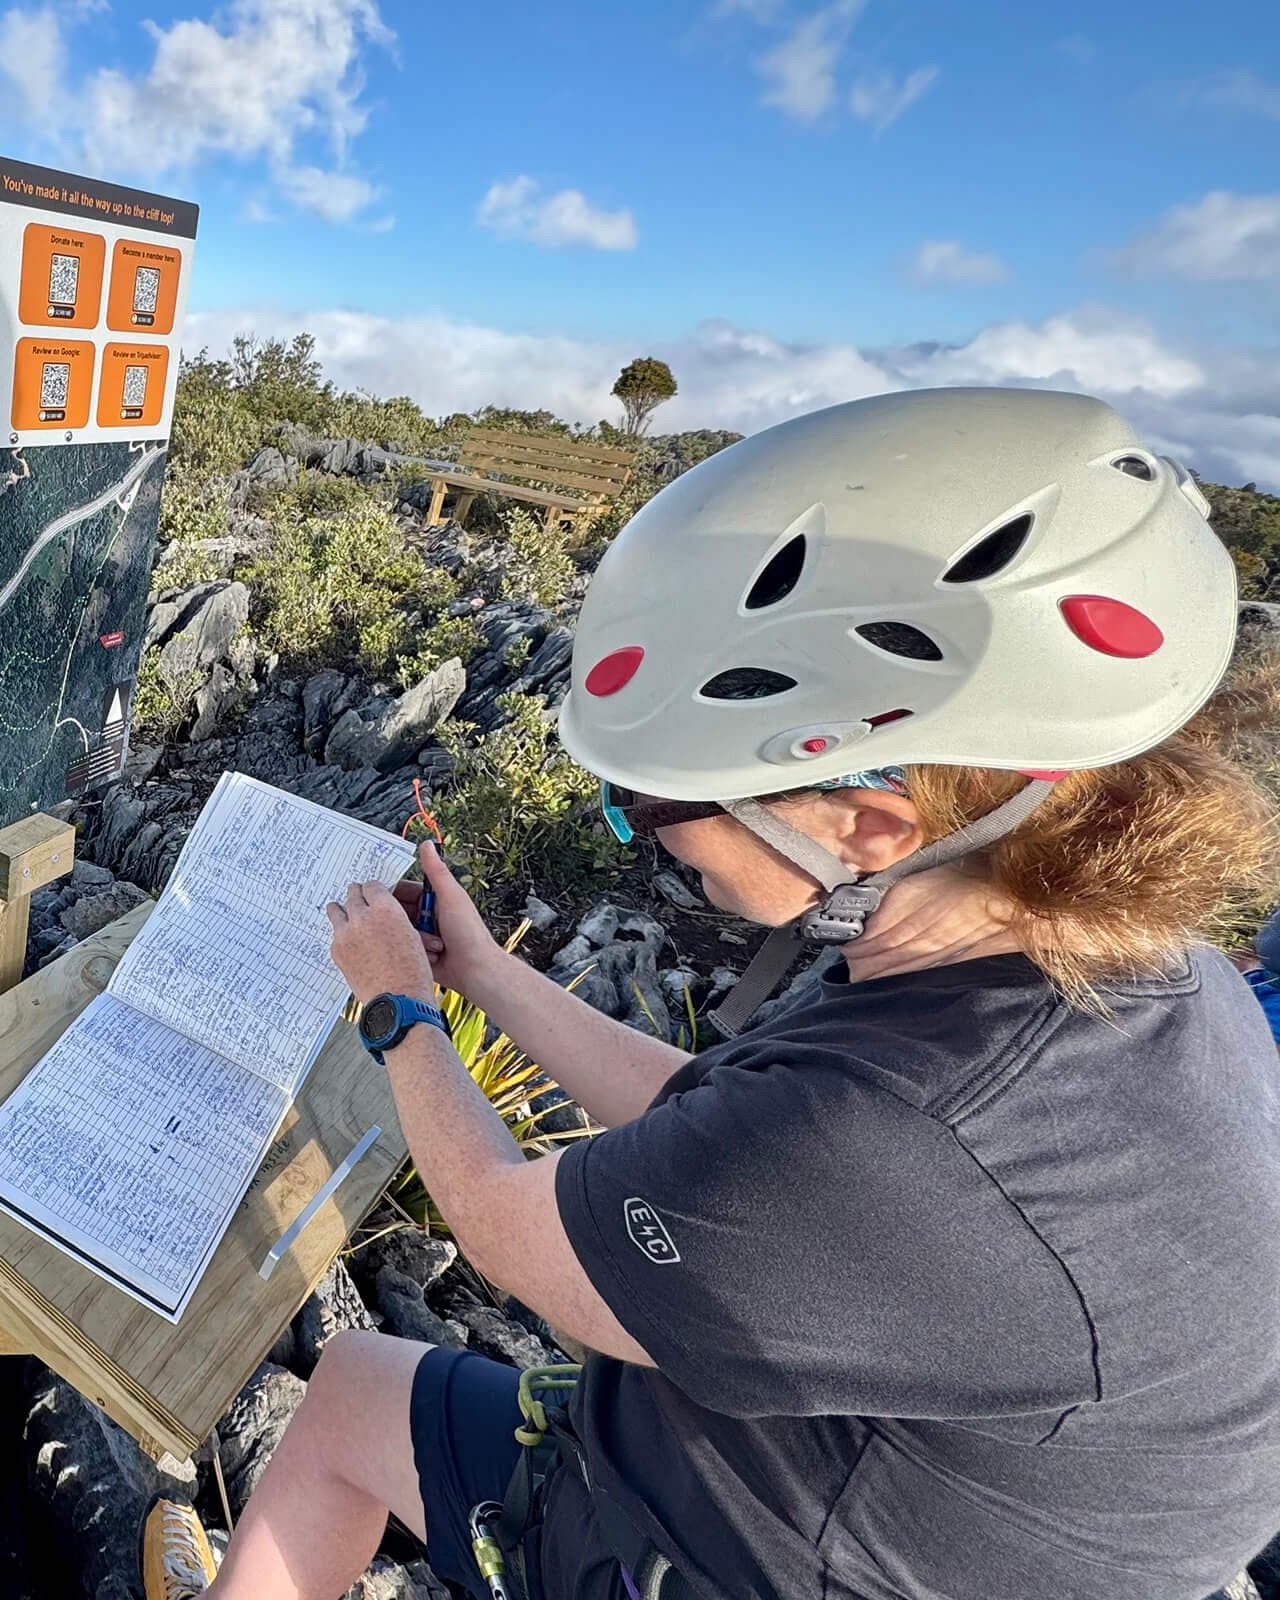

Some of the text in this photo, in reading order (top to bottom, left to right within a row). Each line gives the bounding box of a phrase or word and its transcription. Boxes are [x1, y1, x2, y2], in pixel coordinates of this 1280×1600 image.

[3, 175, 34, 194] You've
[36, 186, 60, 200] made
[62, 188, 68, 202] it
[70, 192, 80, 204] all
[81, 193, 94, 208] the
[96, 198, 112, 214] way
[112, 202, 123, 216] up
[124, 203, 132, 216] to
[133, 204, 144, 218] the
[146, 208, 160, 221] cliff
[160, 211, 175, 226] top!
[50, 234, 70, 246] Donate
[122, 247, 141, 257] Become
[146, 252, 164, 261] member
[32, 346, 52, 354] Review
[113, 350, 129, 358] Review
